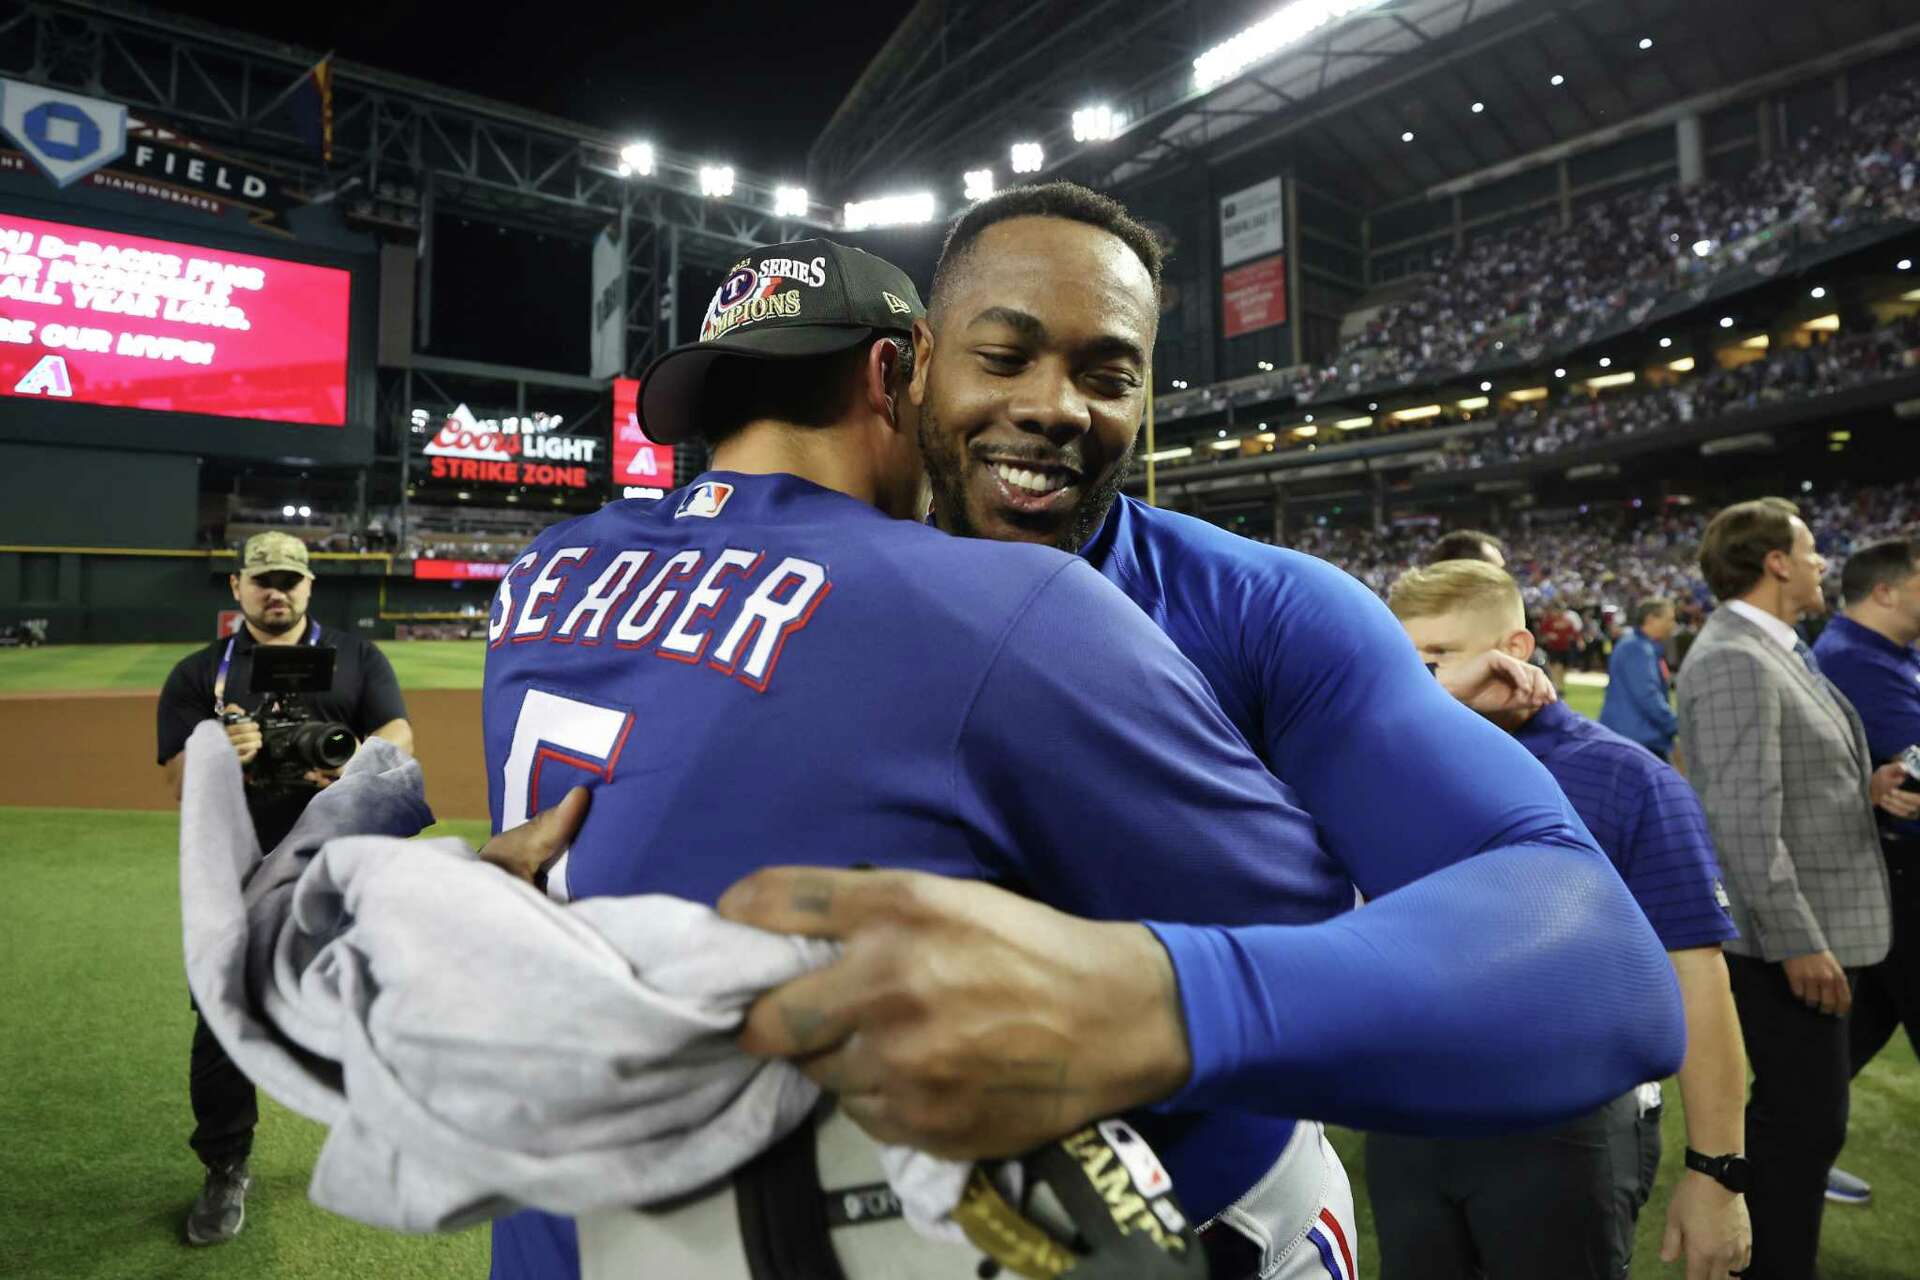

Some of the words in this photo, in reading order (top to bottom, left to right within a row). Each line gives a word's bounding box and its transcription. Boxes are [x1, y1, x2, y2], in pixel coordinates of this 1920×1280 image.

[135, 145, 268, 199] FIELD
[725, 273, 747, 300] T
[758, 256, 826, 288] SERIES
[40, 323, 113, 353] OUR
[522, 434, 598, 462] LIGHT
[431, 456, 518, 483] STRIKE
[522, 462, 588, 488] ZONE
[488, 546, 832, 694] SEAGER
